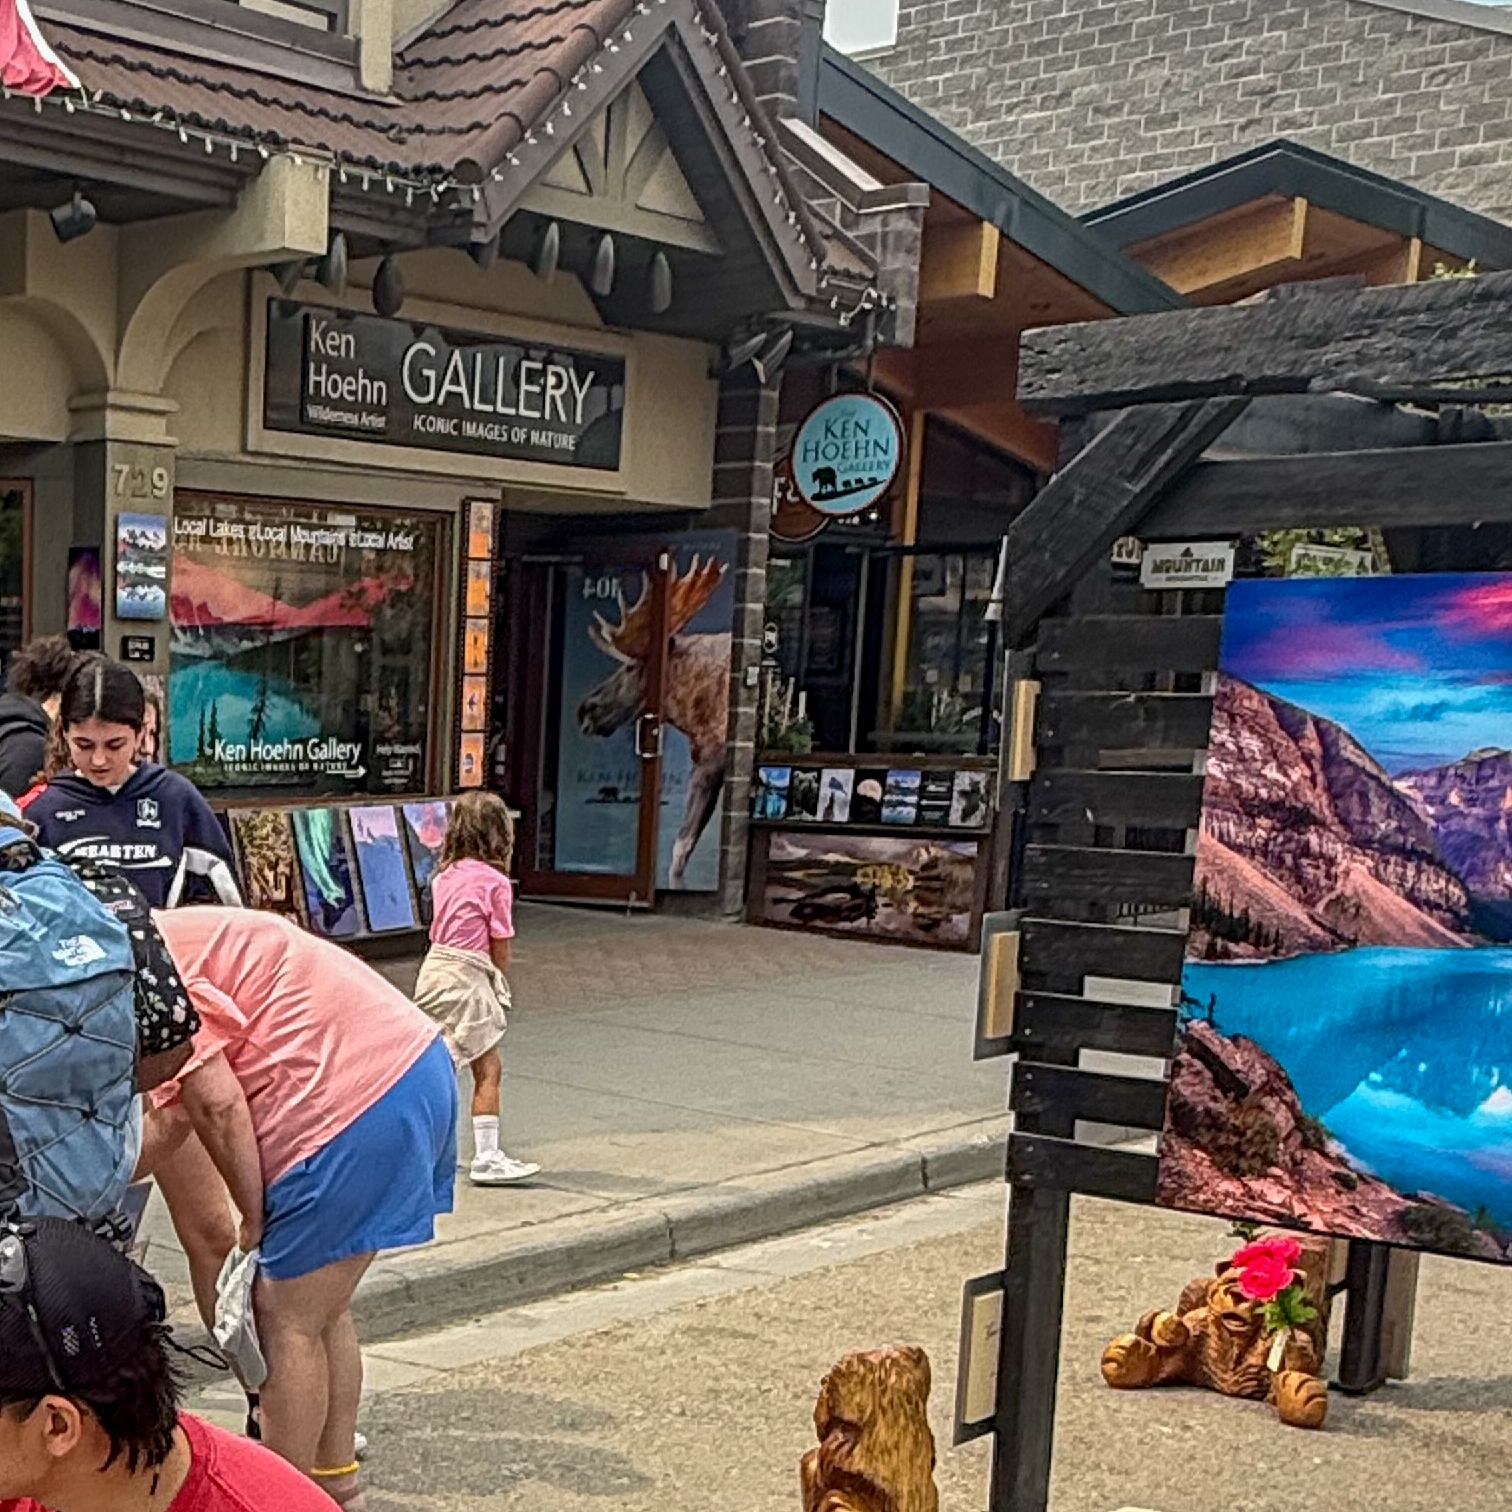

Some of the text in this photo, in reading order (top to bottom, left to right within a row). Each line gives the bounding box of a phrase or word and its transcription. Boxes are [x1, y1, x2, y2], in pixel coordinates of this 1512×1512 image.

[310, 319, 356, 360] Ken
[308, 361, 388, 406] Hoehn
[401, 341, 596, 425] GALLERY
[413, 413, 577, 451] ICONIC IMAGES OF NATURE
[823, 416, 871, 441] KEN
[801, 434, 890, 463] HOEHN
[113, 464, 168, 499] 729
[837, 460, 890, 474] GALLERY
[174, 515, 207, 536] Local
[209, 517, 246, 539] Lakes
[387, 531, 414, 551] Artist
[1150, 558, 1226, 574] MOUNTAIN
[214, 739, 246, 762] Ken
[250, 737, 304, 761] Hoehn
[307, 736, 362, 765] Gallery
